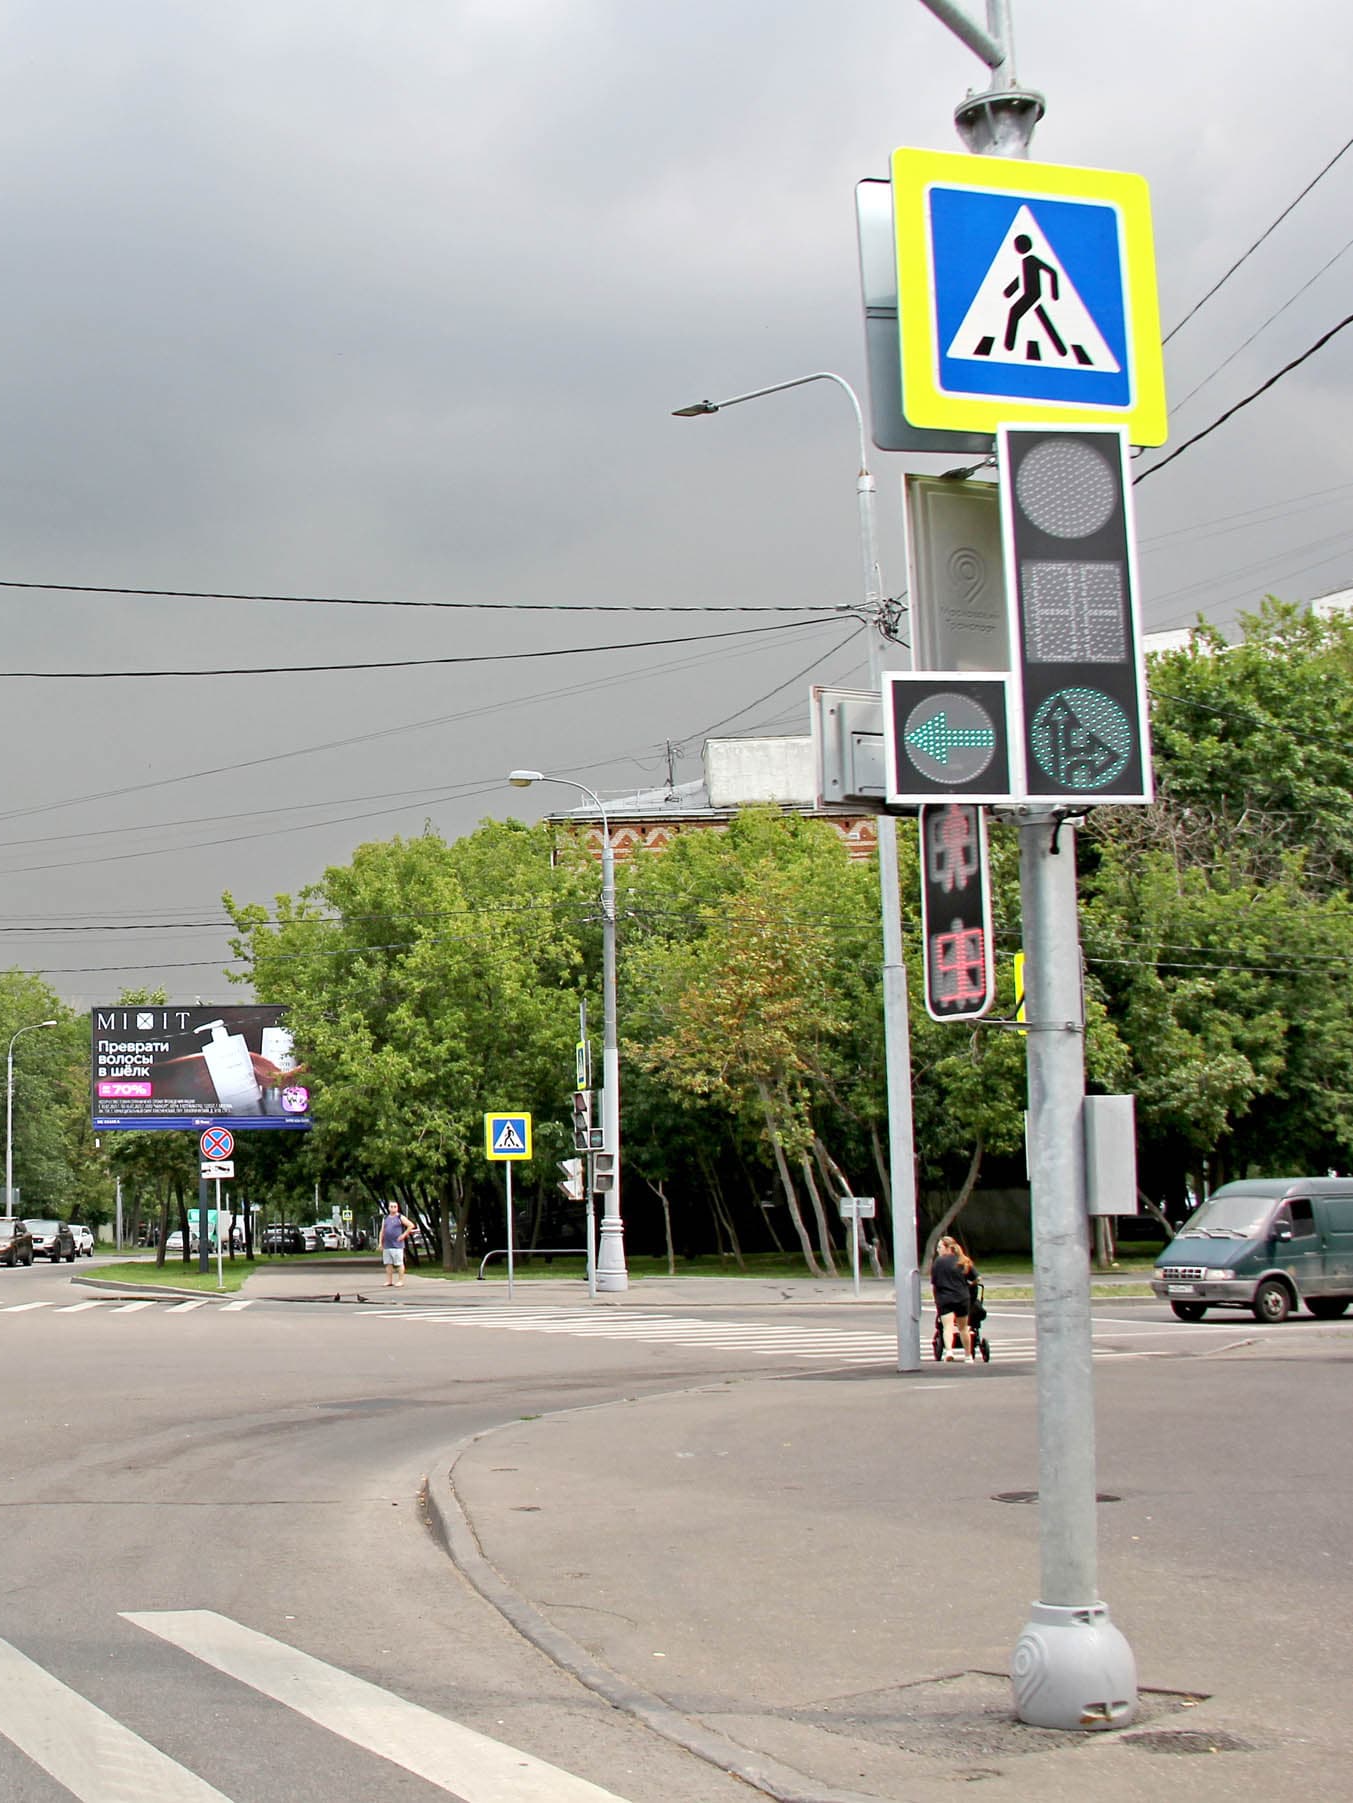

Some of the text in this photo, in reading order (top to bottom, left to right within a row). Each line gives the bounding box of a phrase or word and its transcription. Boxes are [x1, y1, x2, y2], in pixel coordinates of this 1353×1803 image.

[98, 1040, 170, 1054] Преврати
[98, 1054, 154, 1065] волосы
[98, 1064, 151, 1077] в шёлк
